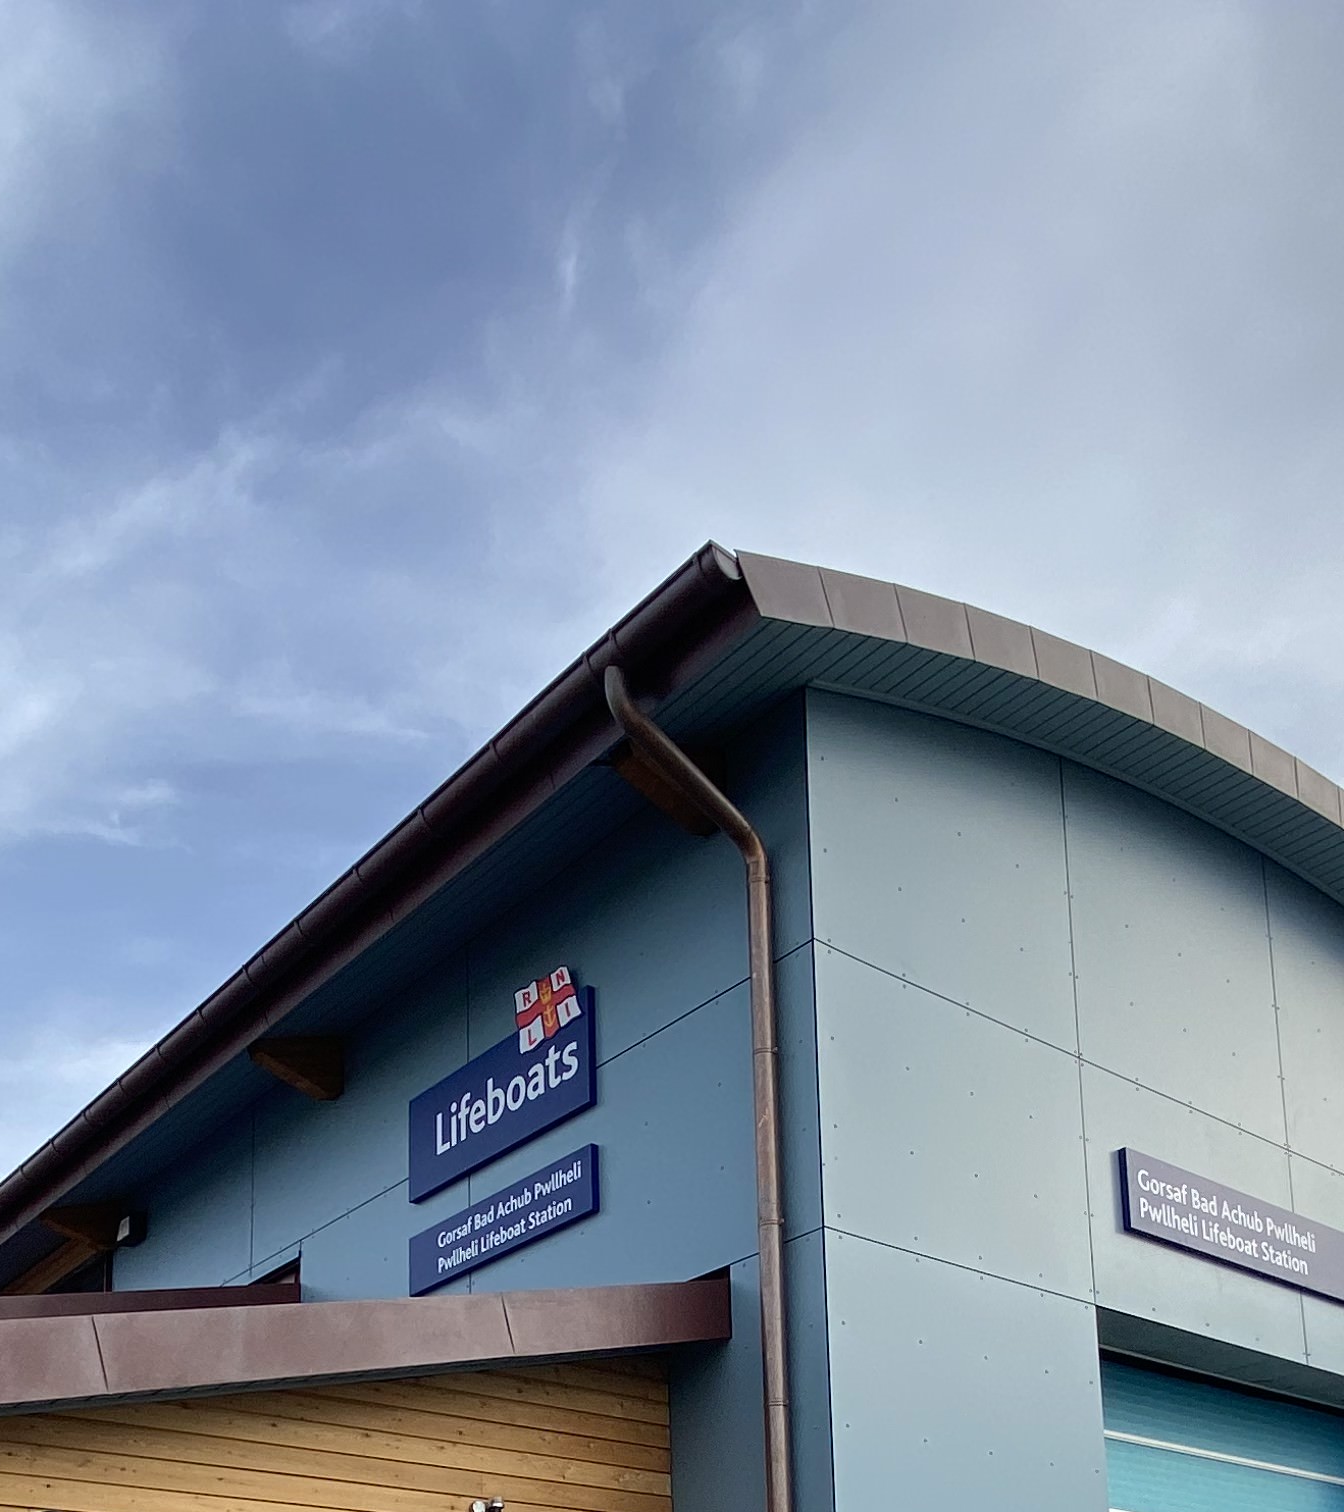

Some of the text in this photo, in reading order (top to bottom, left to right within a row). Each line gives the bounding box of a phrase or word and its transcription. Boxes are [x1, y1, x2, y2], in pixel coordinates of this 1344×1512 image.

[436, 1041, 578, 1156] Lifeboats
[438, 1160, 582, 1248] Gorsaf Bad Achub Pwllheli
[438, 1198, 572, 1273] Pwllheli Lifeboat Station
[1137, 1169, 1317, 1253] Gorsaf Bad Achub Pwllheli
[1139, 1197, 1309, 1275] Pwllheli Lifeboat Station
